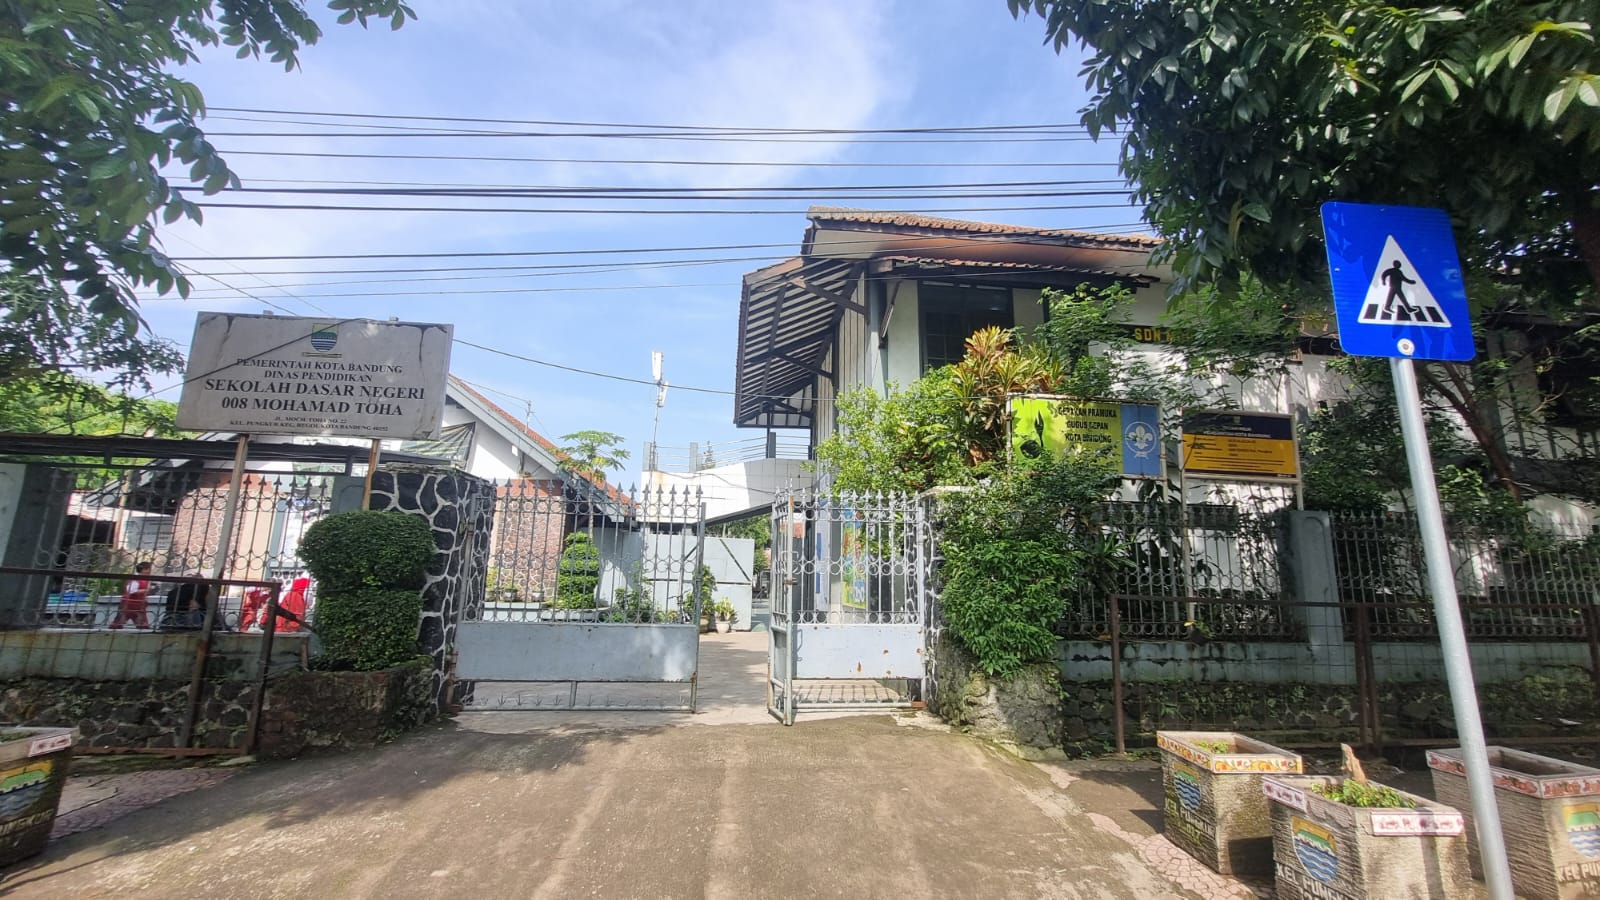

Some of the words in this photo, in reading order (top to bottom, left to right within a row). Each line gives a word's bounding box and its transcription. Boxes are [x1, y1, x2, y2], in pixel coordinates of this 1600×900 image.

[1134, 326, 1161, 342] SDN
[237, 358, 311, 369] PEMERINTAH
[314, 361, 345, 371] KOTA
[348, 363, 403, 374] BANDUNG
[264, 370, 299, 379] DINAS
[301, 371, 373, 383] PENDIDIKAN
[204, 378, 291, 394] SEKOLAH
[295, 382, 354, 397] DASAR
[359, 385, 424, 400] NEGERI
[221, 396, 248, 409] 008
[252, 398, 350, 413] MOHAMAD
[355, 402, 403, 416] TOHA
[1087, 407, 1118, 418] PRAMUKA
[1066, 420, 1088, 429] GUGUS
[1064, 432, 1082, 442] KOTA
